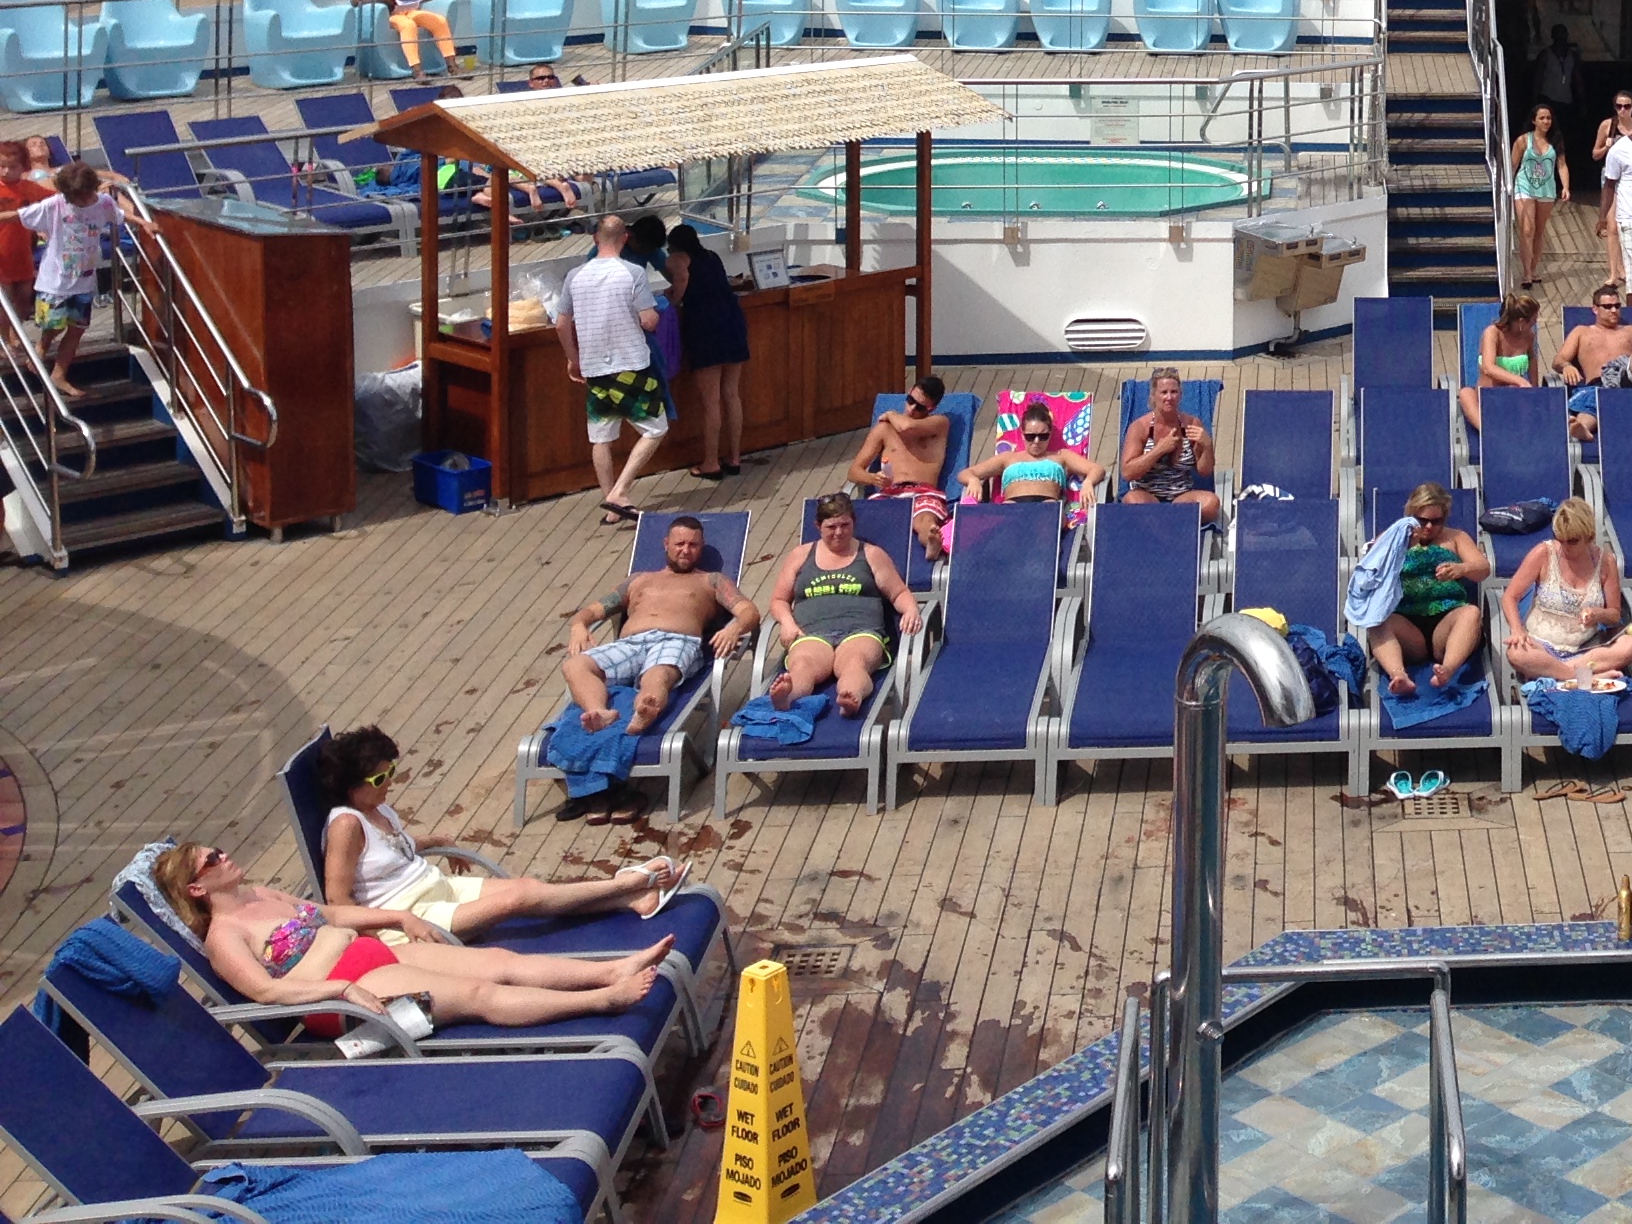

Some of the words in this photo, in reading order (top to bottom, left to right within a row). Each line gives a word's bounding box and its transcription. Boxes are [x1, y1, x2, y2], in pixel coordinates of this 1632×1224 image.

[735, 1059, 759, 1077] CAUTION
[769, 1054, 794, 1075] CAUTION
[736, 1109, 755, 1126] WET
[775, 1102, 794, 1123] WET
[731, 1126, 759, 1145] FLOOR
[772, 1117, 800, 1143] FLOOR
[735, 1153, 754, 1171] PISO
[778, 1146, 798, 1167] PISO
[726, 1168, 762, 1191] MOJADO
[771, 1158, 808, 1188] MOJADO
